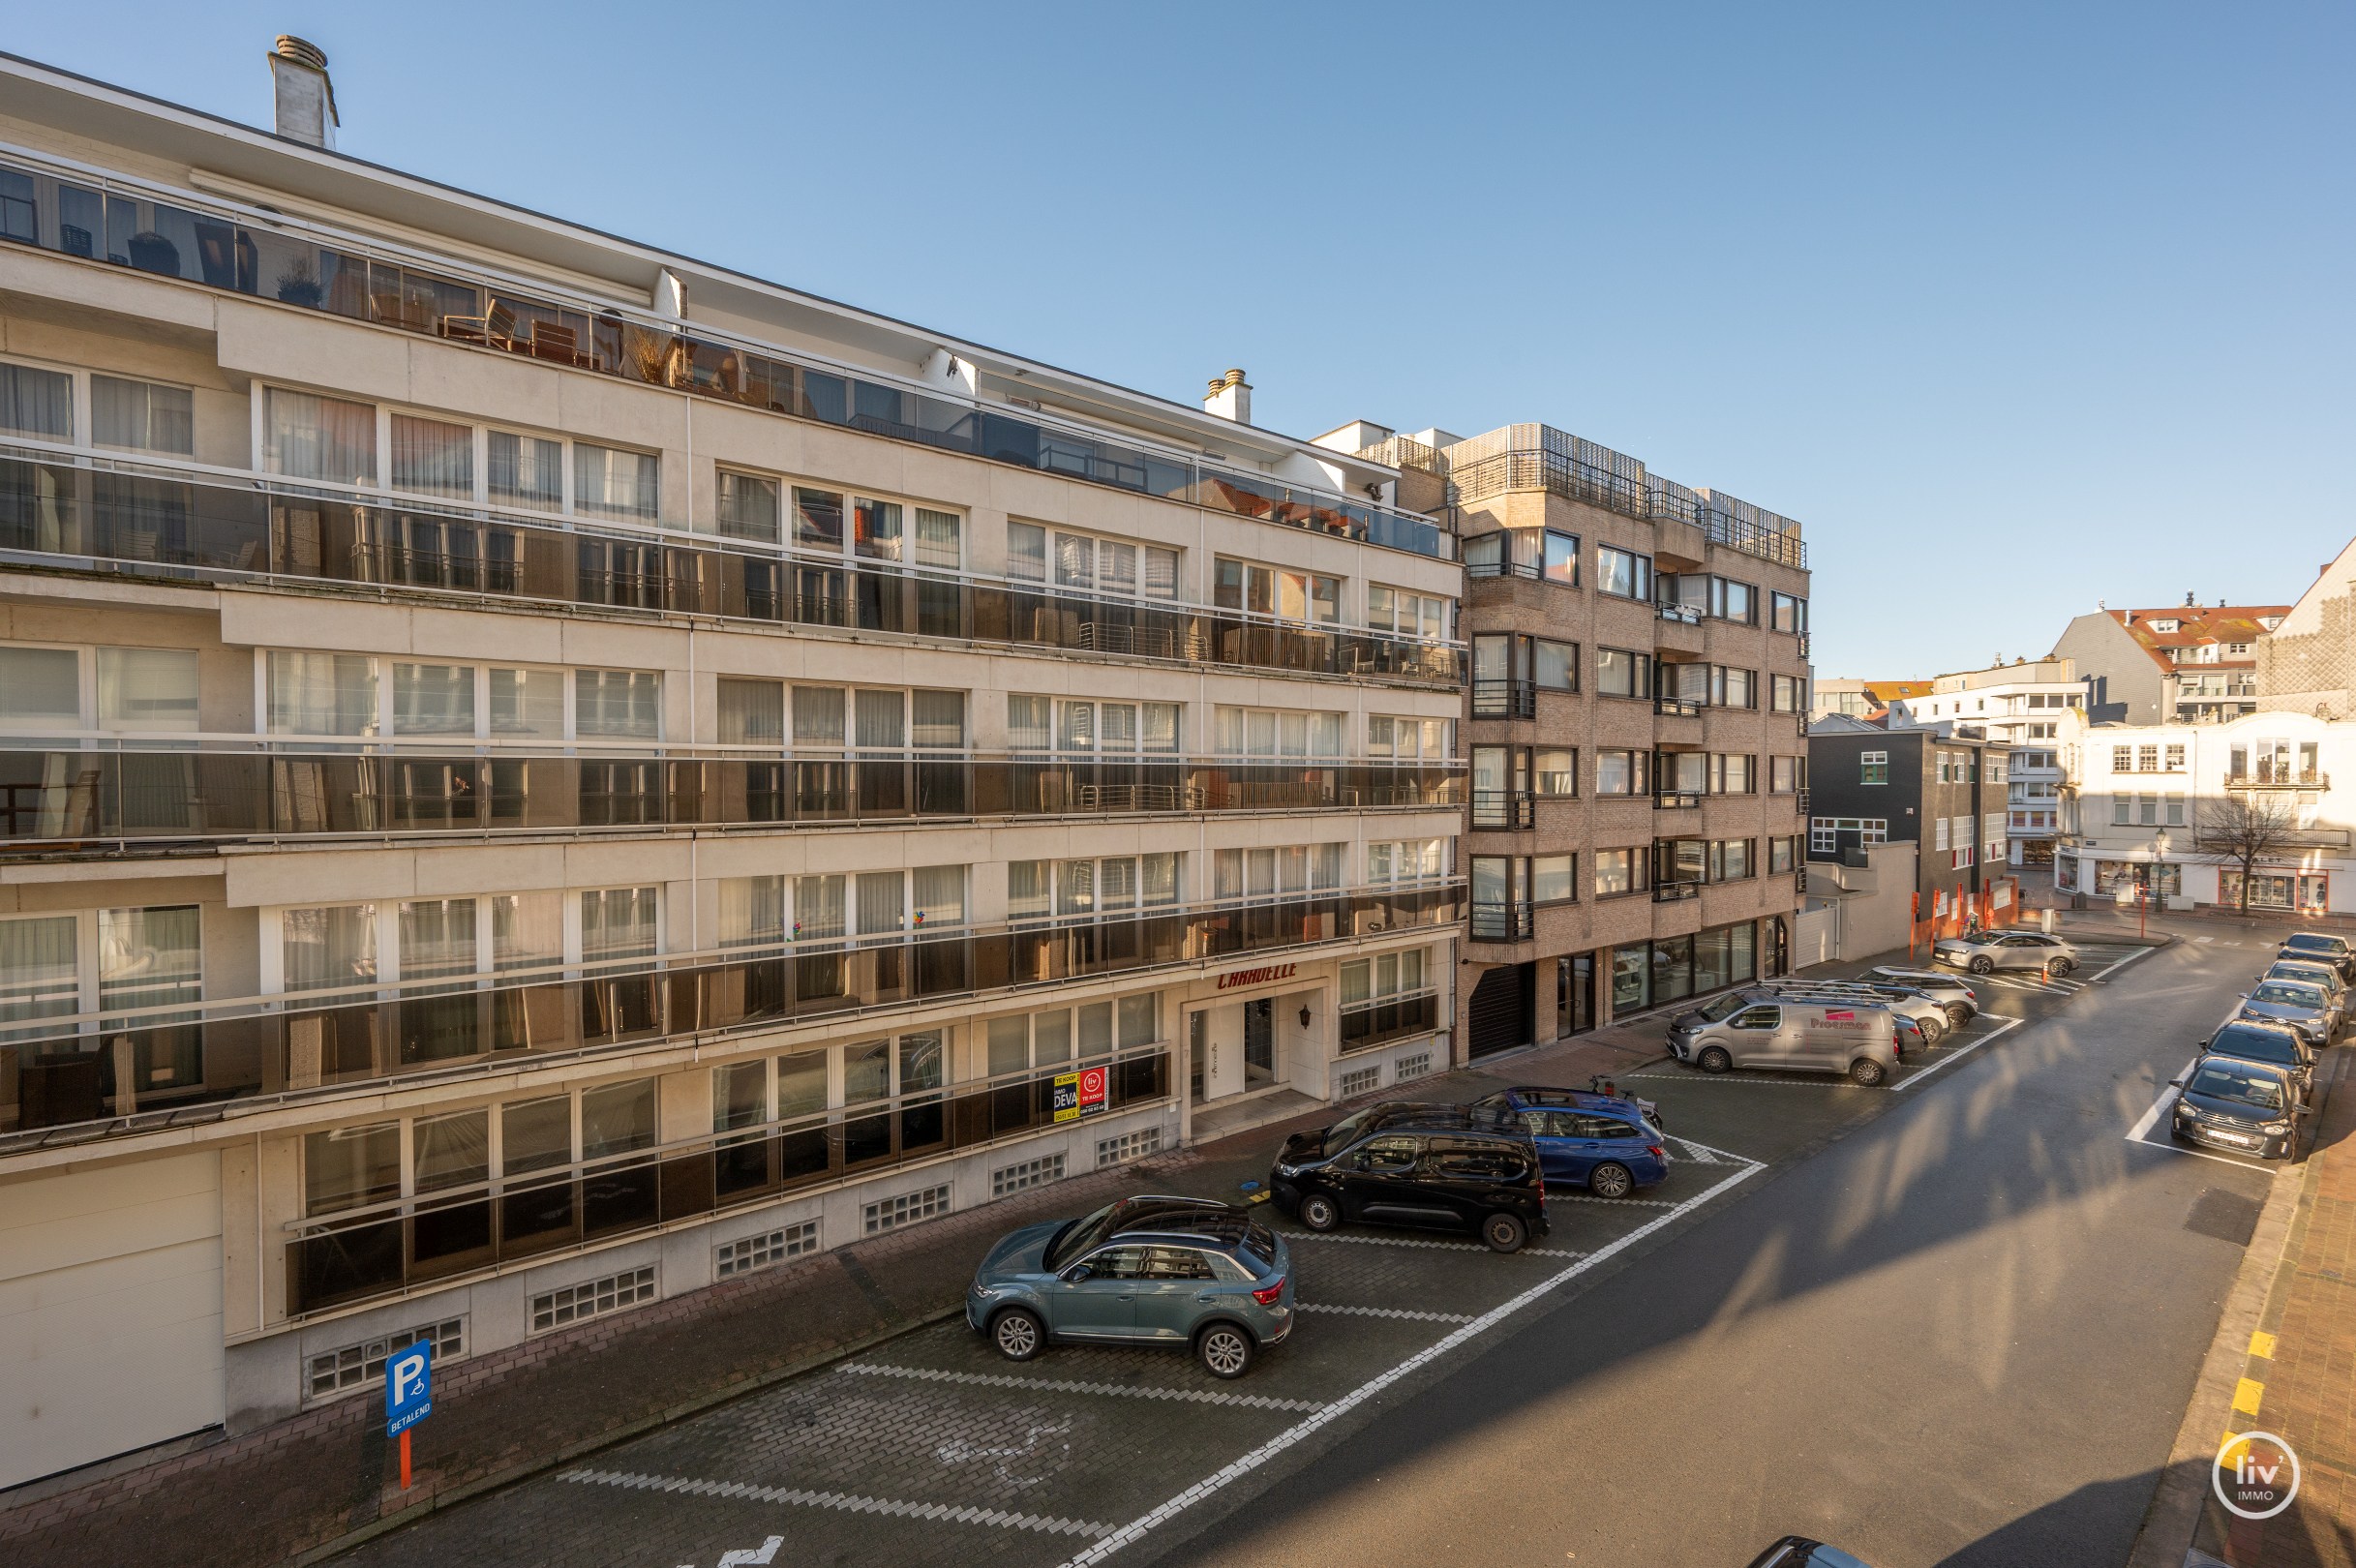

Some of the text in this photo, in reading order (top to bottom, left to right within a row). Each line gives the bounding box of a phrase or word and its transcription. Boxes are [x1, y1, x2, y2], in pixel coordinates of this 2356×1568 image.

[1055, 1092, 1076, 1108] DEVA
[394, 1354, 425, 1406] P
[391, 1402, 431, 1432] BETALEND
